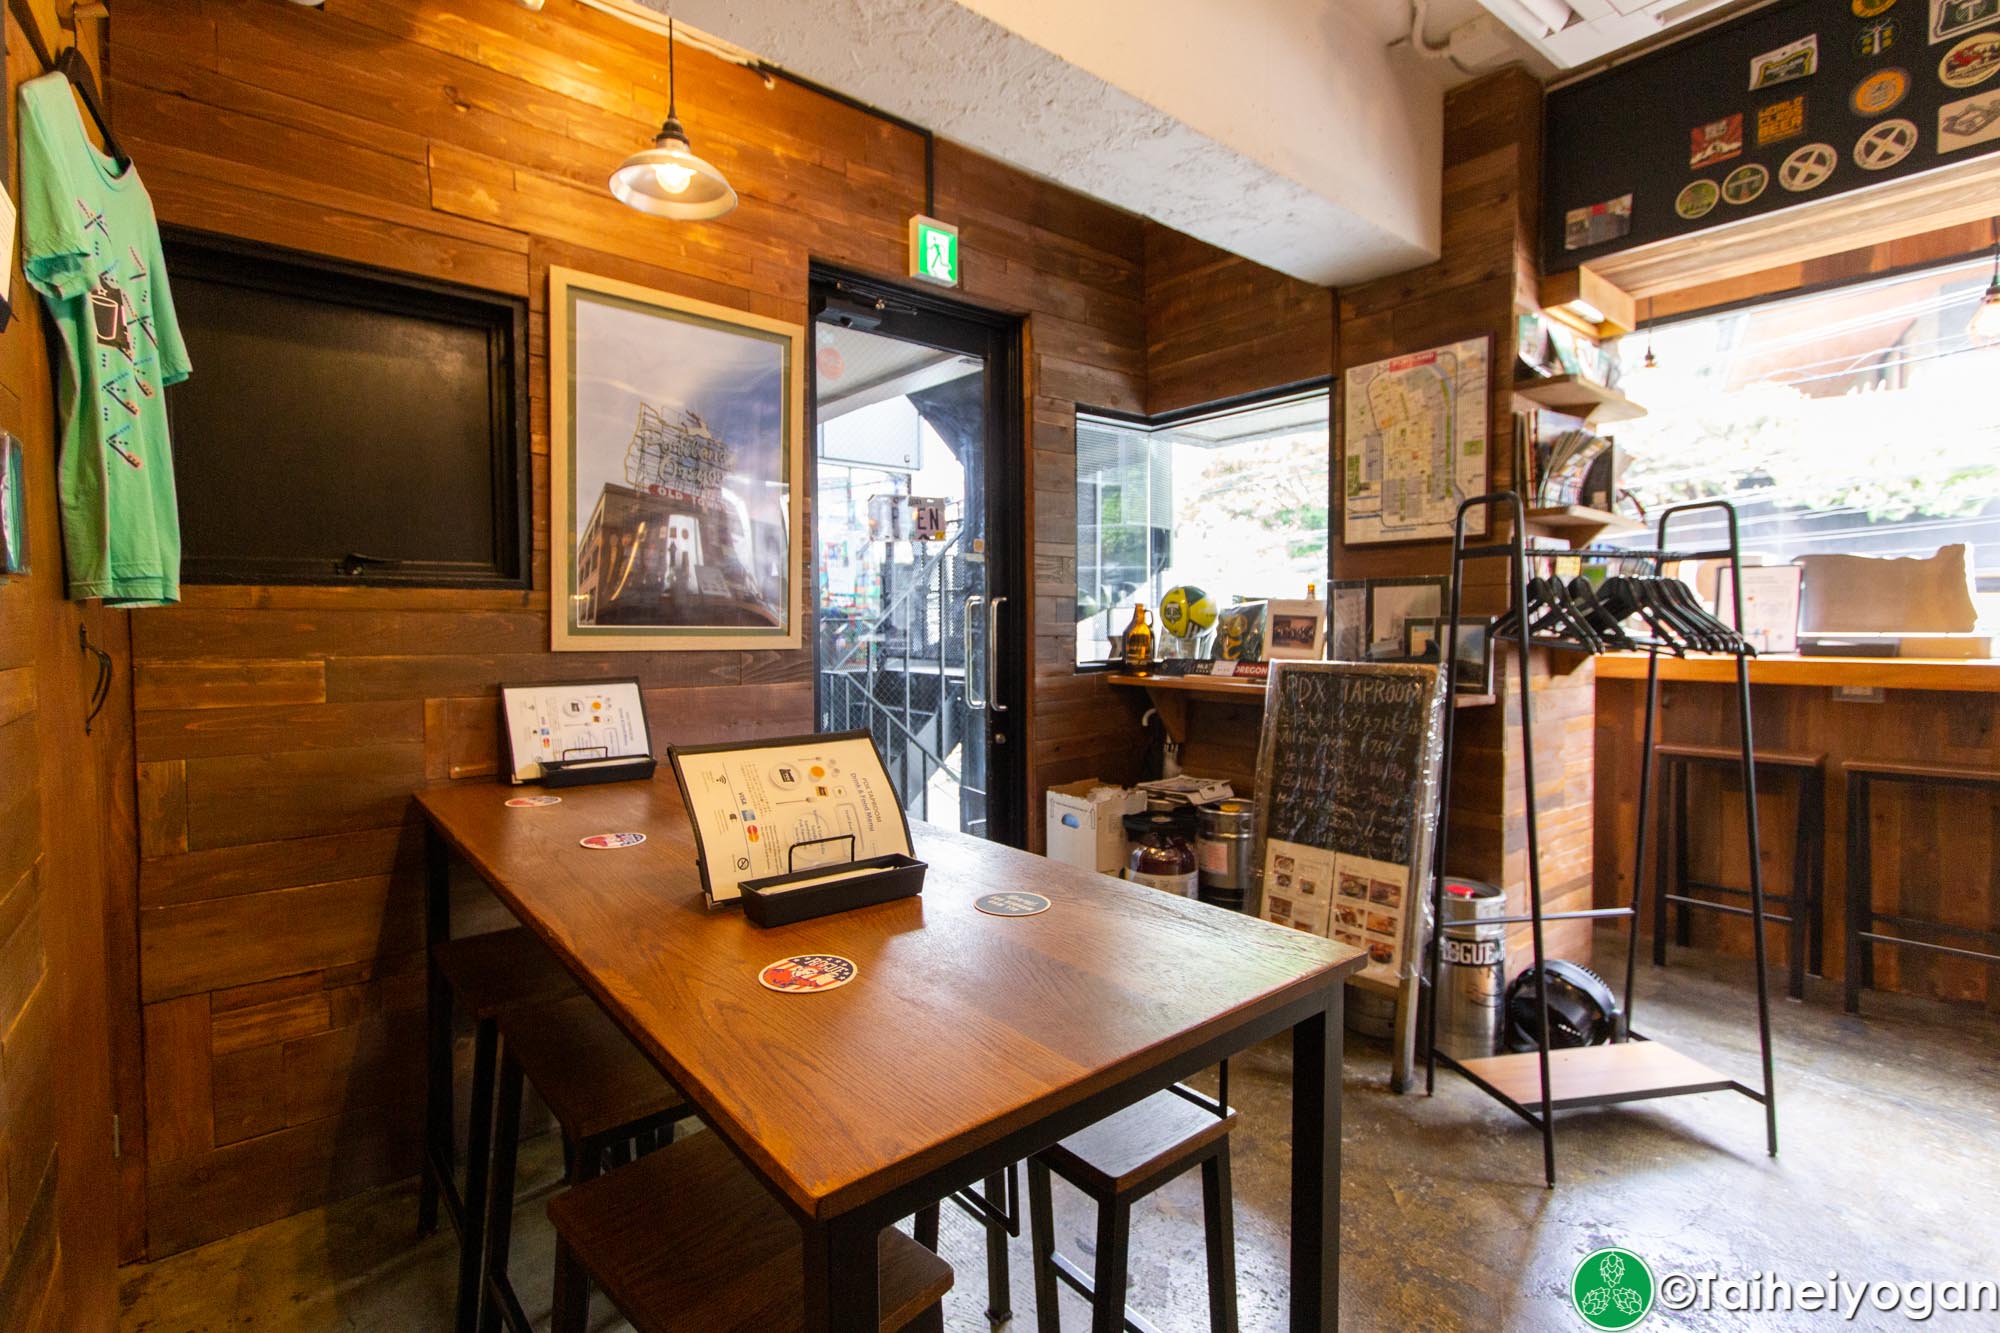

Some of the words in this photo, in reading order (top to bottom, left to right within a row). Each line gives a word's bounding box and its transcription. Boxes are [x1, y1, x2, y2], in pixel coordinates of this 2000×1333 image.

[657, 486, 684, 501] OLD
[692, 495, 726, 513] TOWN
[1286, 675, 1327, 703] PDX
[1343, 678, 1423, 704] TAPROOM
[850, 772, 861, 788] Drink
[860, 795, 870, 812] Food
[866, 812, 875, 832] Menu
[868, 790, 882, 823] TAPROOM
